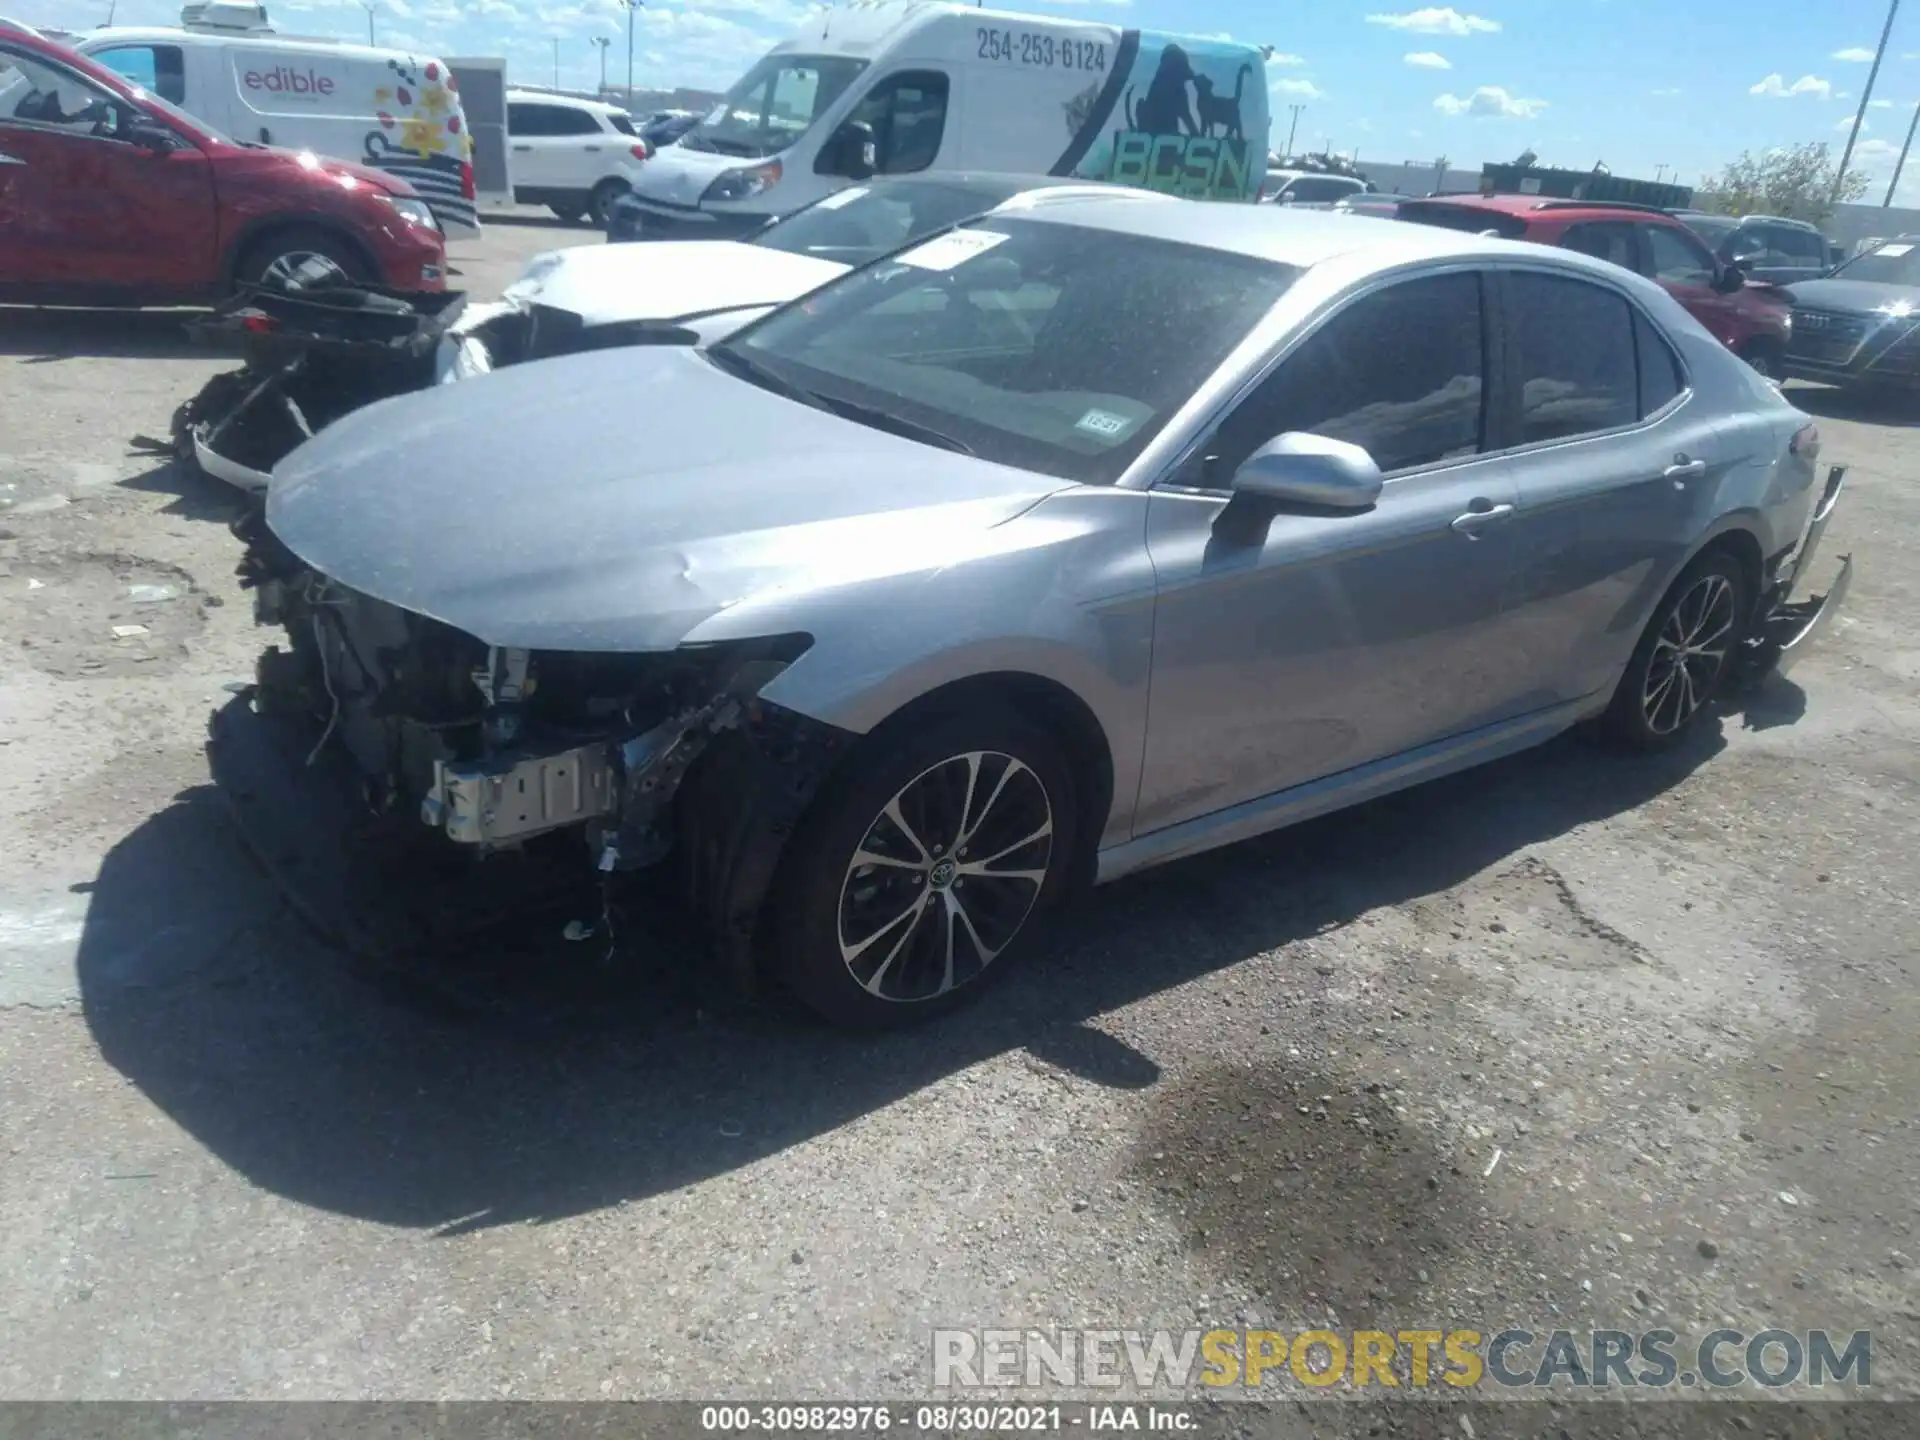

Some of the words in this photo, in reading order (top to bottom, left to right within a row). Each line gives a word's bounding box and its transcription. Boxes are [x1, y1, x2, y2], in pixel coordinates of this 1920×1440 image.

[976, 27, 1107, 72] 254-253-6124
[244, 65, 335, 96] edible
[1112, 131, 1252, 198] BCSN
